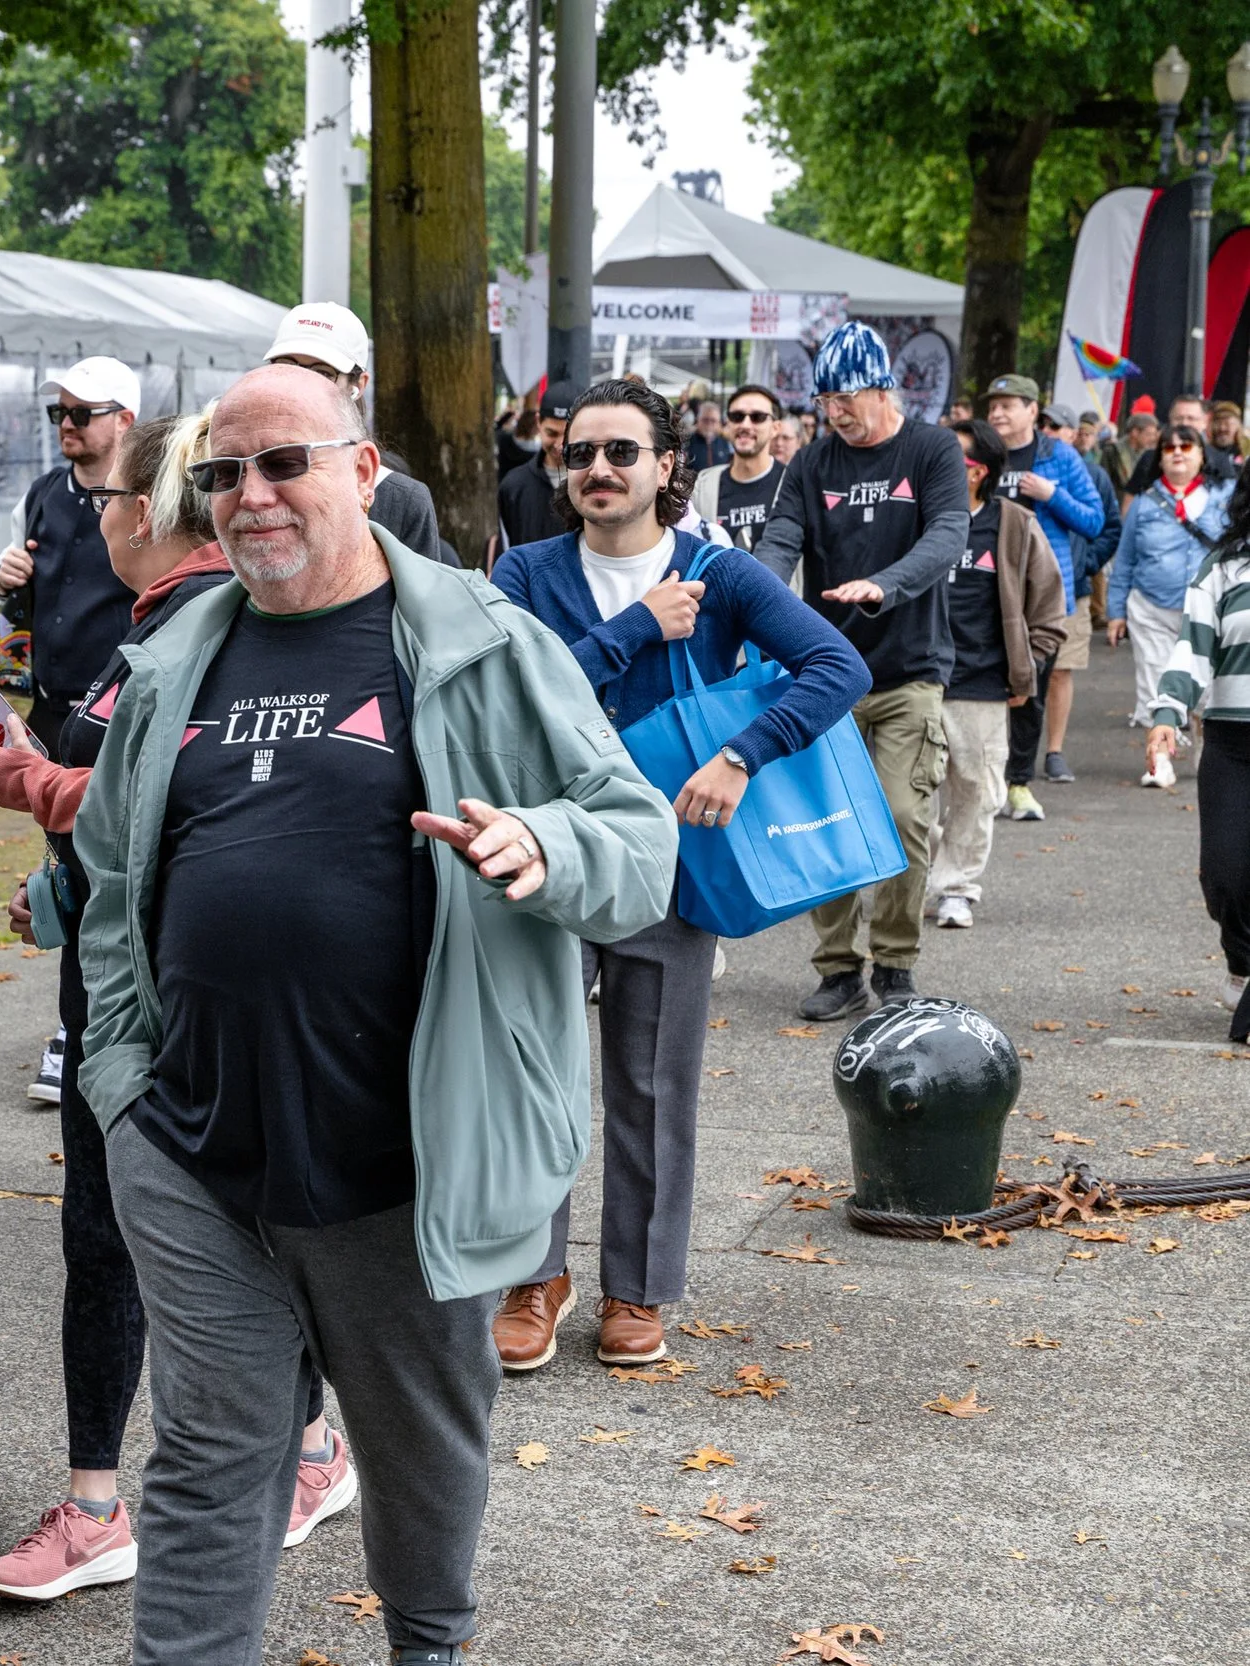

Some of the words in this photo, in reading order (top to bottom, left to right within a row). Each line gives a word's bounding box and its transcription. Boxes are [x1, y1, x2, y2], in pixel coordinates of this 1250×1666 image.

[848, 486, 889, 505] LIFE
[730, 509, 766, 527] LIFE
[230, 699, 256, 712] ALL
[258, 694, 307, 708] WALKS
[308, 693, 330, 705] OF
[220, 706, 325, 744] LIFE
[253, 757, 273, 766] WALK
[254, 749, 275, 758] AIDS
[251, 772, 271, 782] WEST
